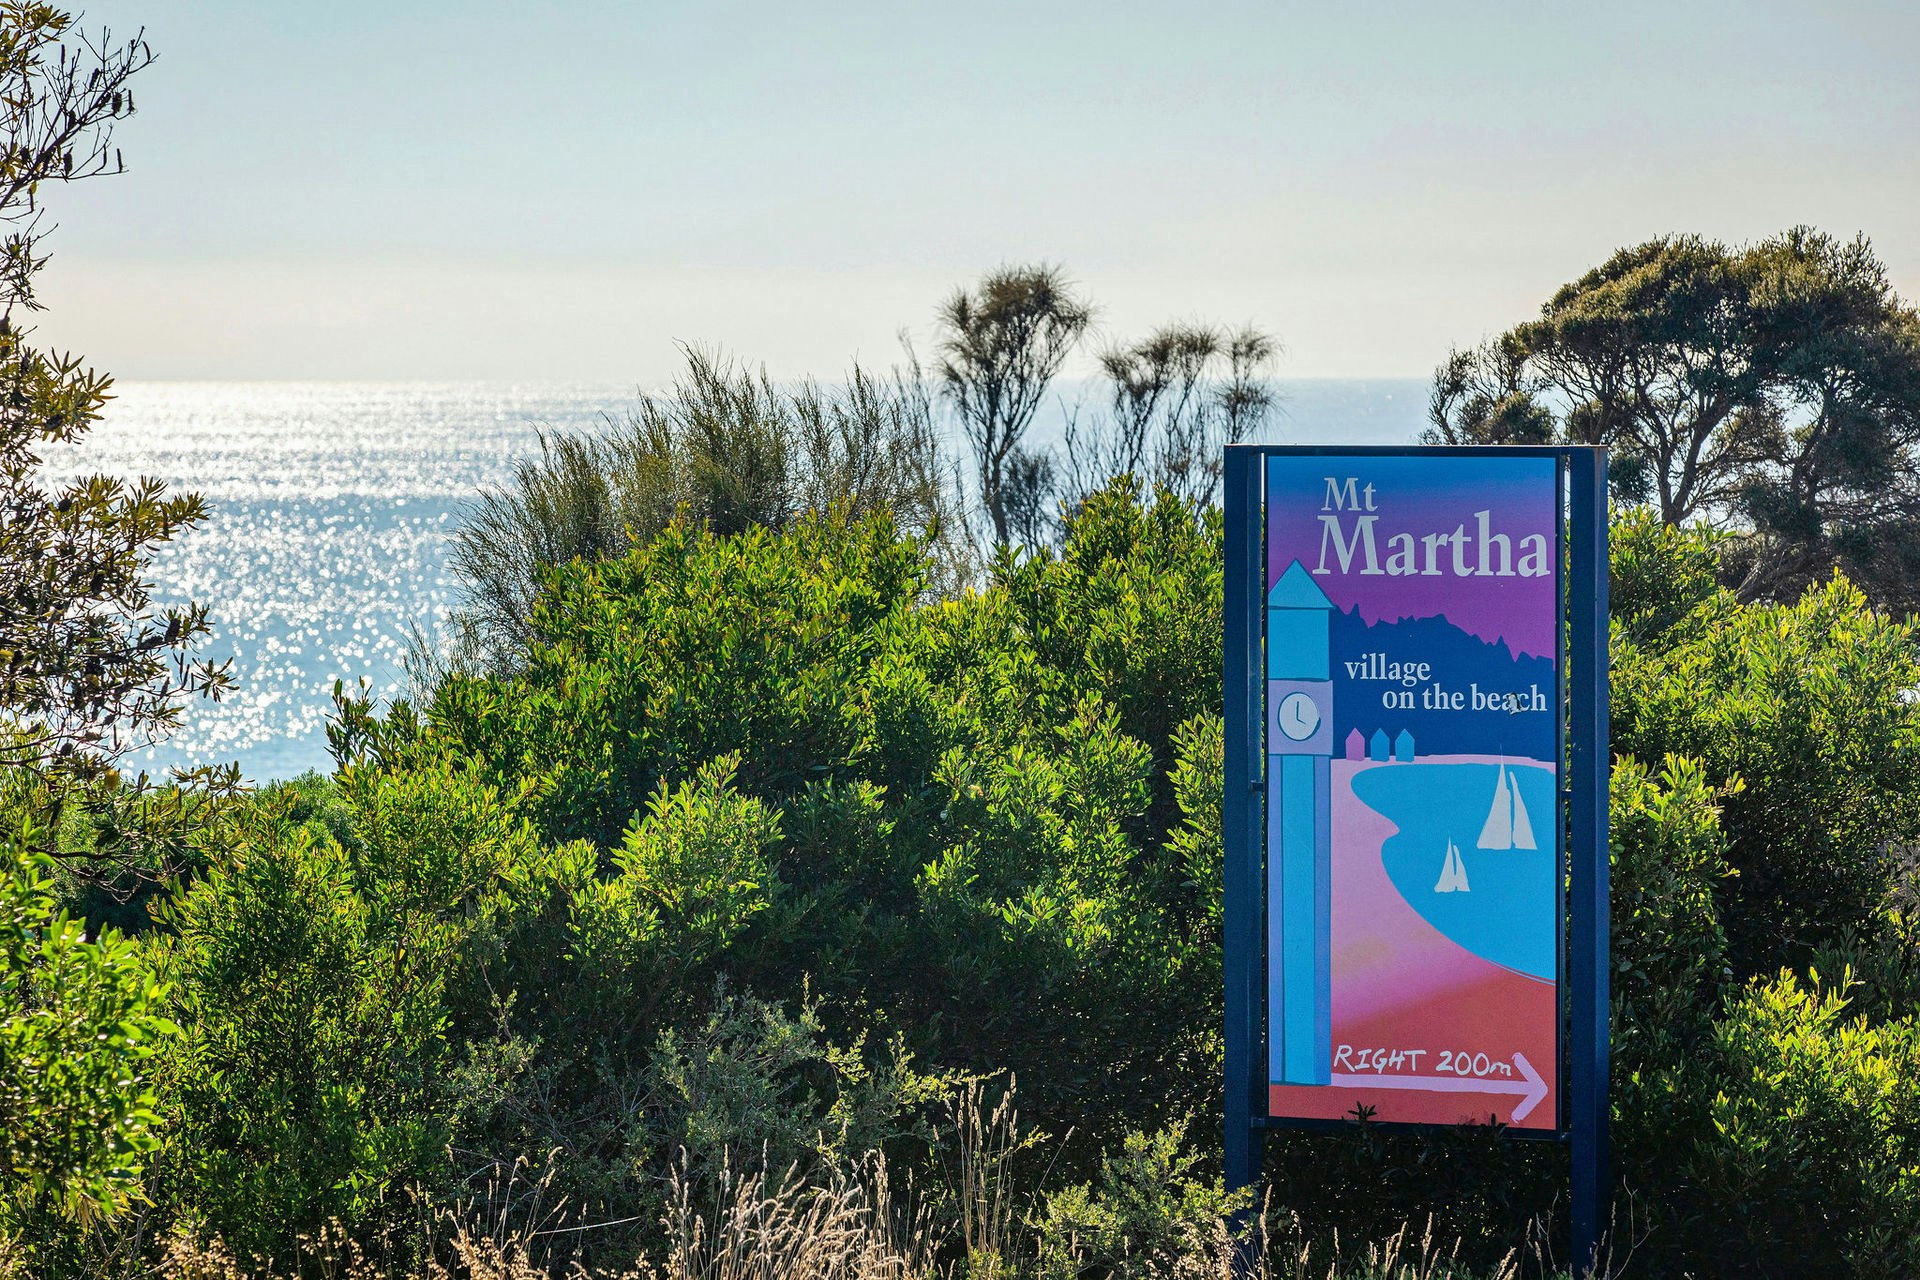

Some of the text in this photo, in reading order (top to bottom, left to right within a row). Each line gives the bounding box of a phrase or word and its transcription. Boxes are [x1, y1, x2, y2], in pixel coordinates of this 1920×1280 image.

[1321, 477, 1378, 511] Mt
[1312, 510, 1550, 577] Martha
[1344, 653, 1431, 686] village
[1382, 690, 1415, 709] on
[1422, 683, 1465, 710] the
[1333, 1045, 1511, 1077] RIGHT 200m
